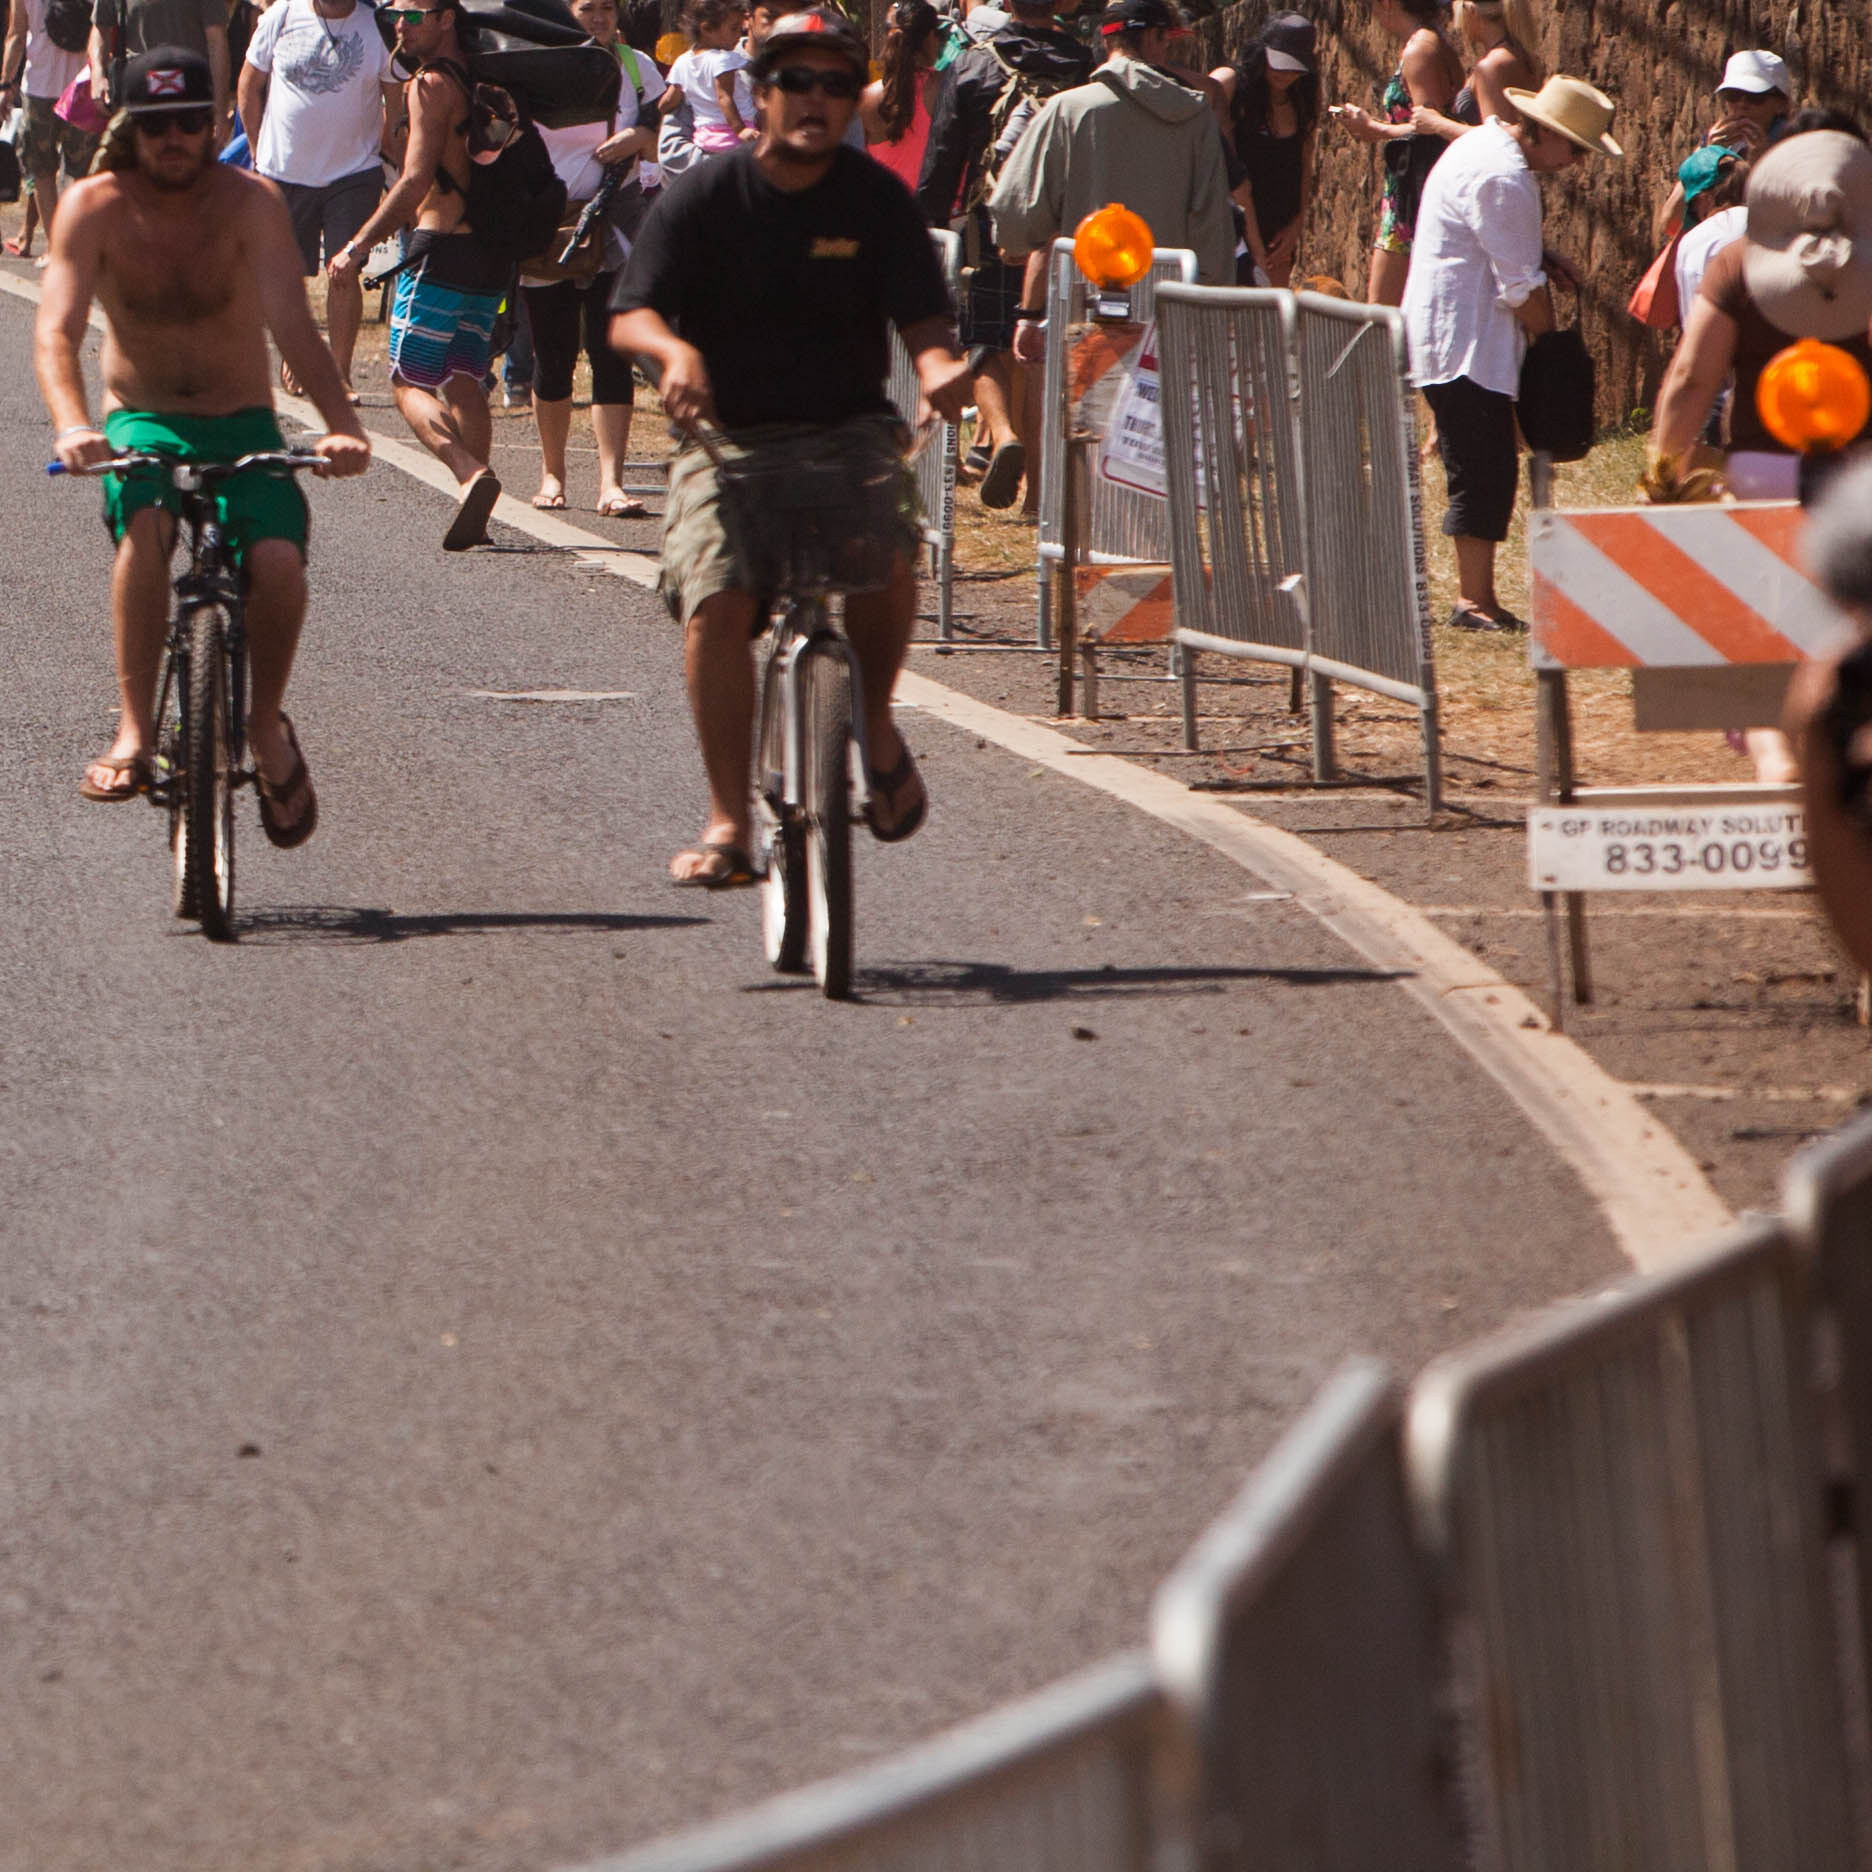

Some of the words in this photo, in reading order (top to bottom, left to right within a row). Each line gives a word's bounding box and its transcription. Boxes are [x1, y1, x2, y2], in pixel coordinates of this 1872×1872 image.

[1410, 495, 1425, 575] SOLUTIONS
[1602, 817, 1713, 835] ROADWAY
[1607, 840, 1807, 874] 833-0099
